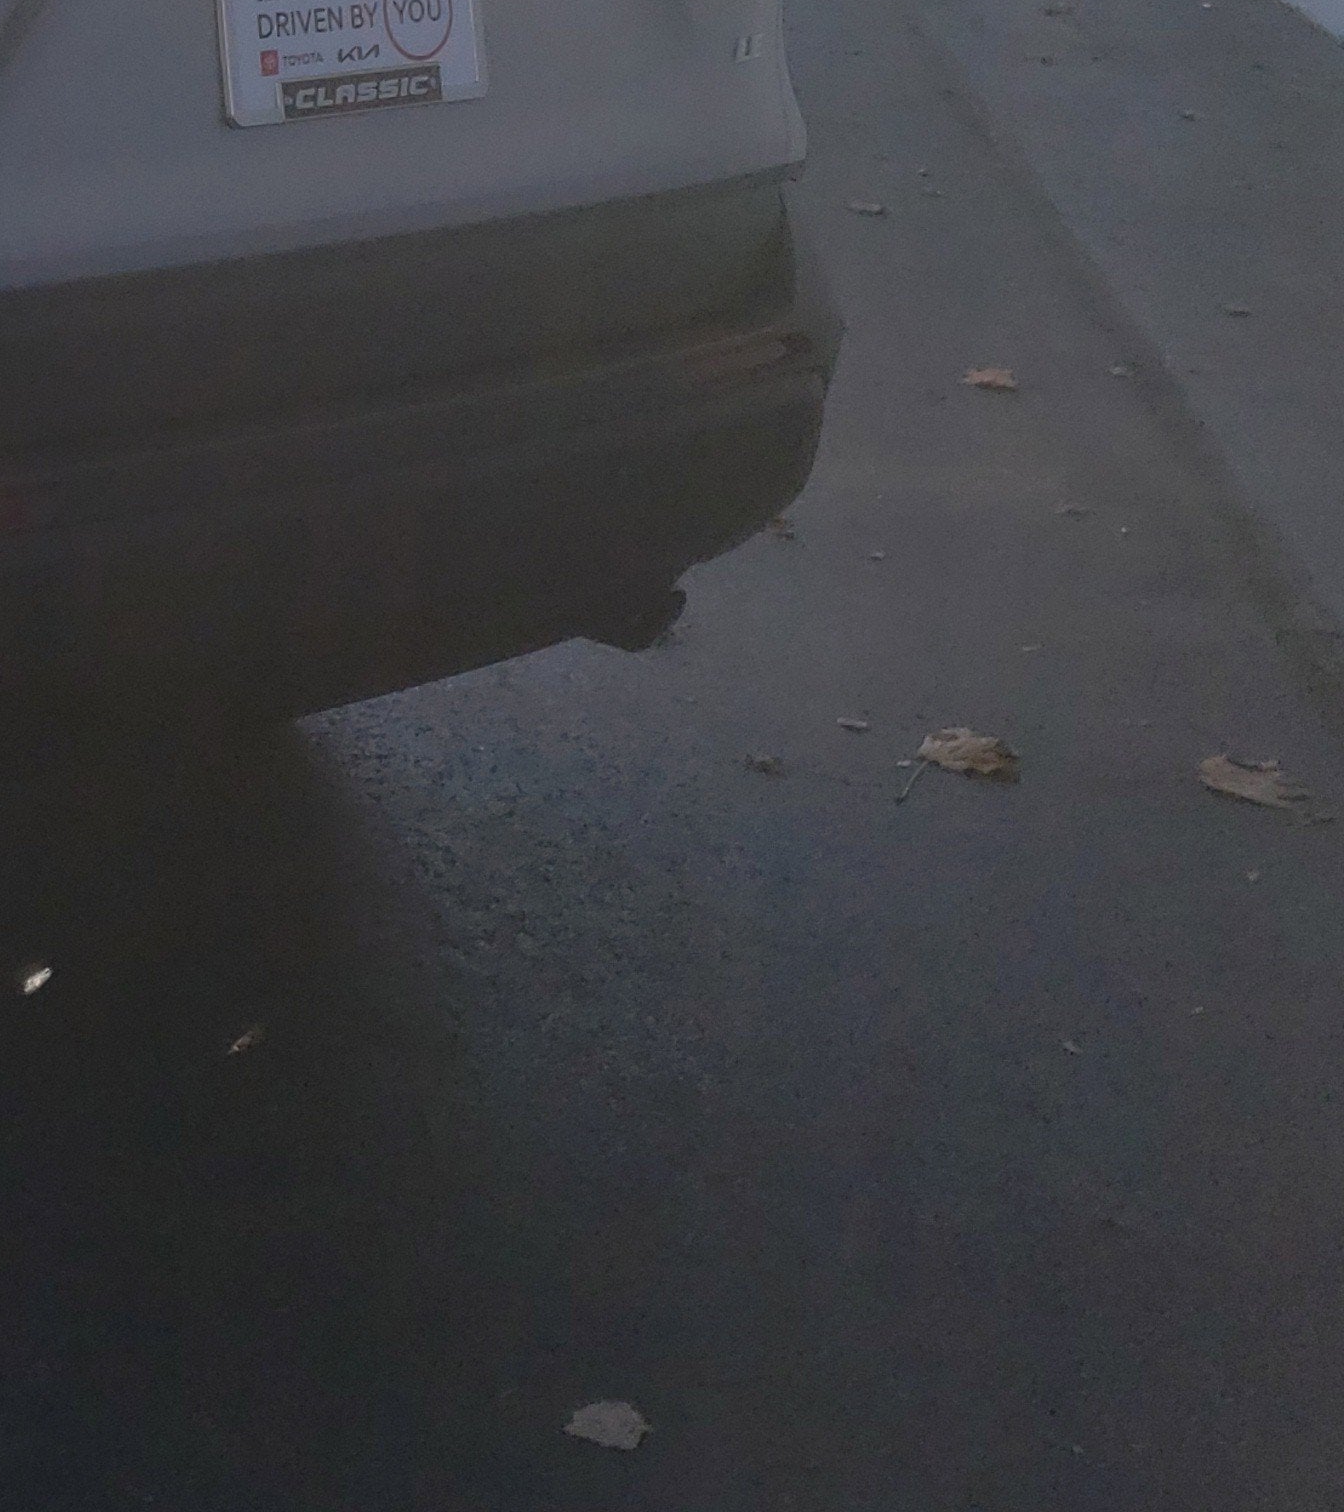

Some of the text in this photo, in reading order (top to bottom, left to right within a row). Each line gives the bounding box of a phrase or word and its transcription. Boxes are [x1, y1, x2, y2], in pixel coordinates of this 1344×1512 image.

[257, 7, 343, 39] DRIVEN
[351, 2, 378, 29] BY
[283, 51, 324, 67] TOYOTA
[295, 76, 430, 110] CLASSIC
